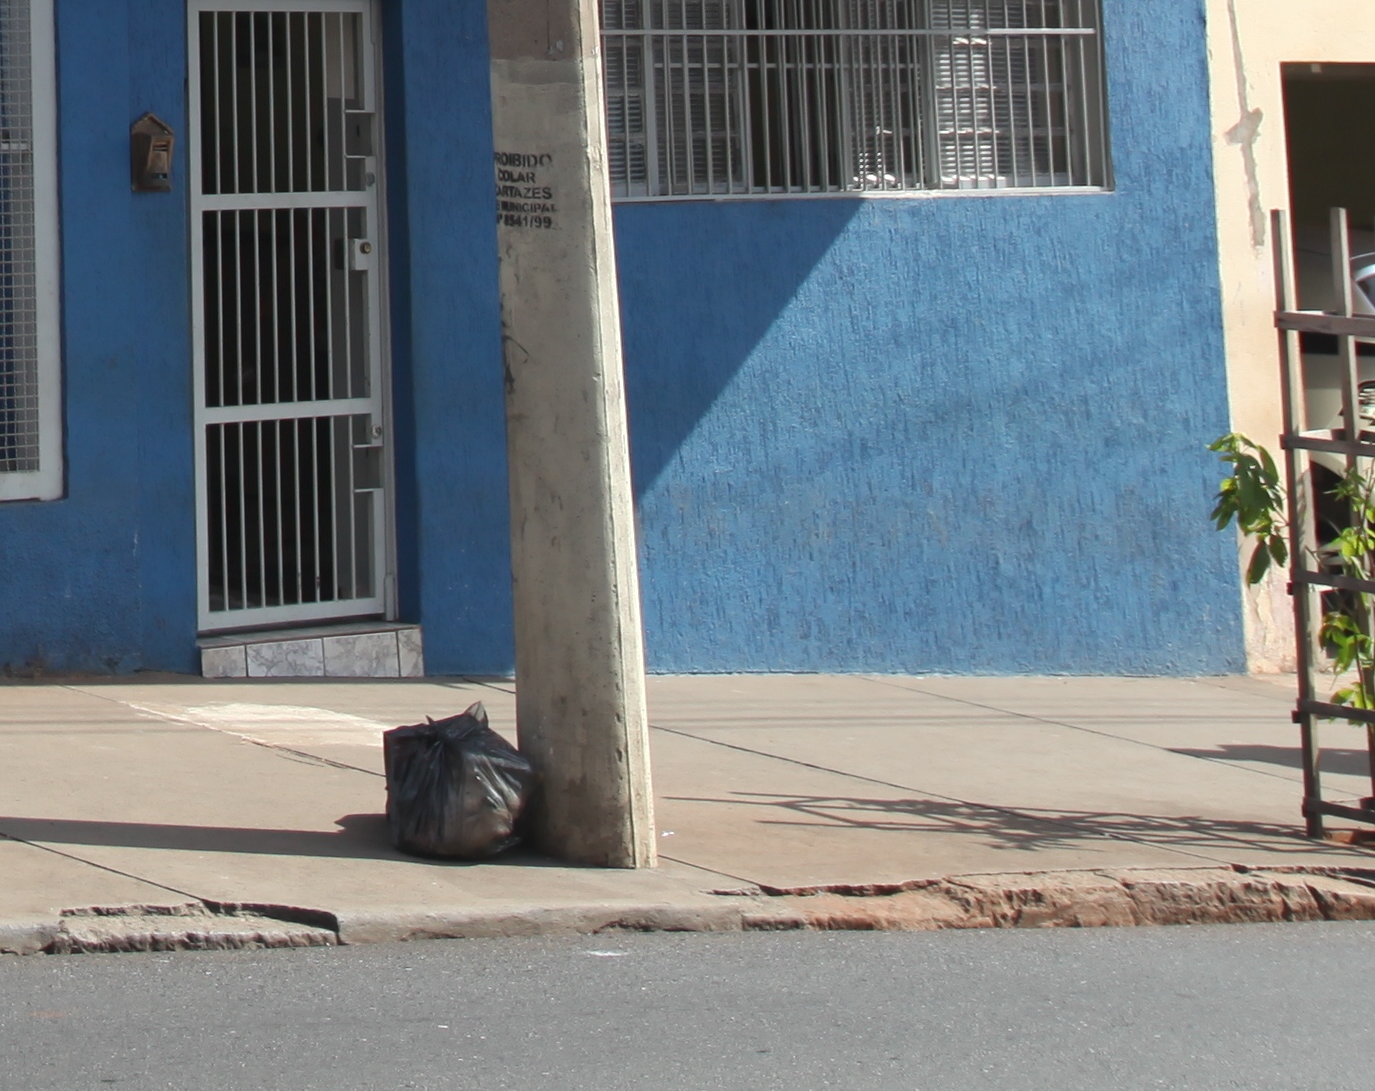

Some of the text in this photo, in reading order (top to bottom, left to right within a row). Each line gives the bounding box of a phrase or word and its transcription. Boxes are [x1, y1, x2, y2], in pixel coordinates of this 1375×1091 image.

[494, 152, 553, 168] ROIBIDO
[498, 168, 536, 184] COLAR
[495, 185, 553, 200] ARTAZES
